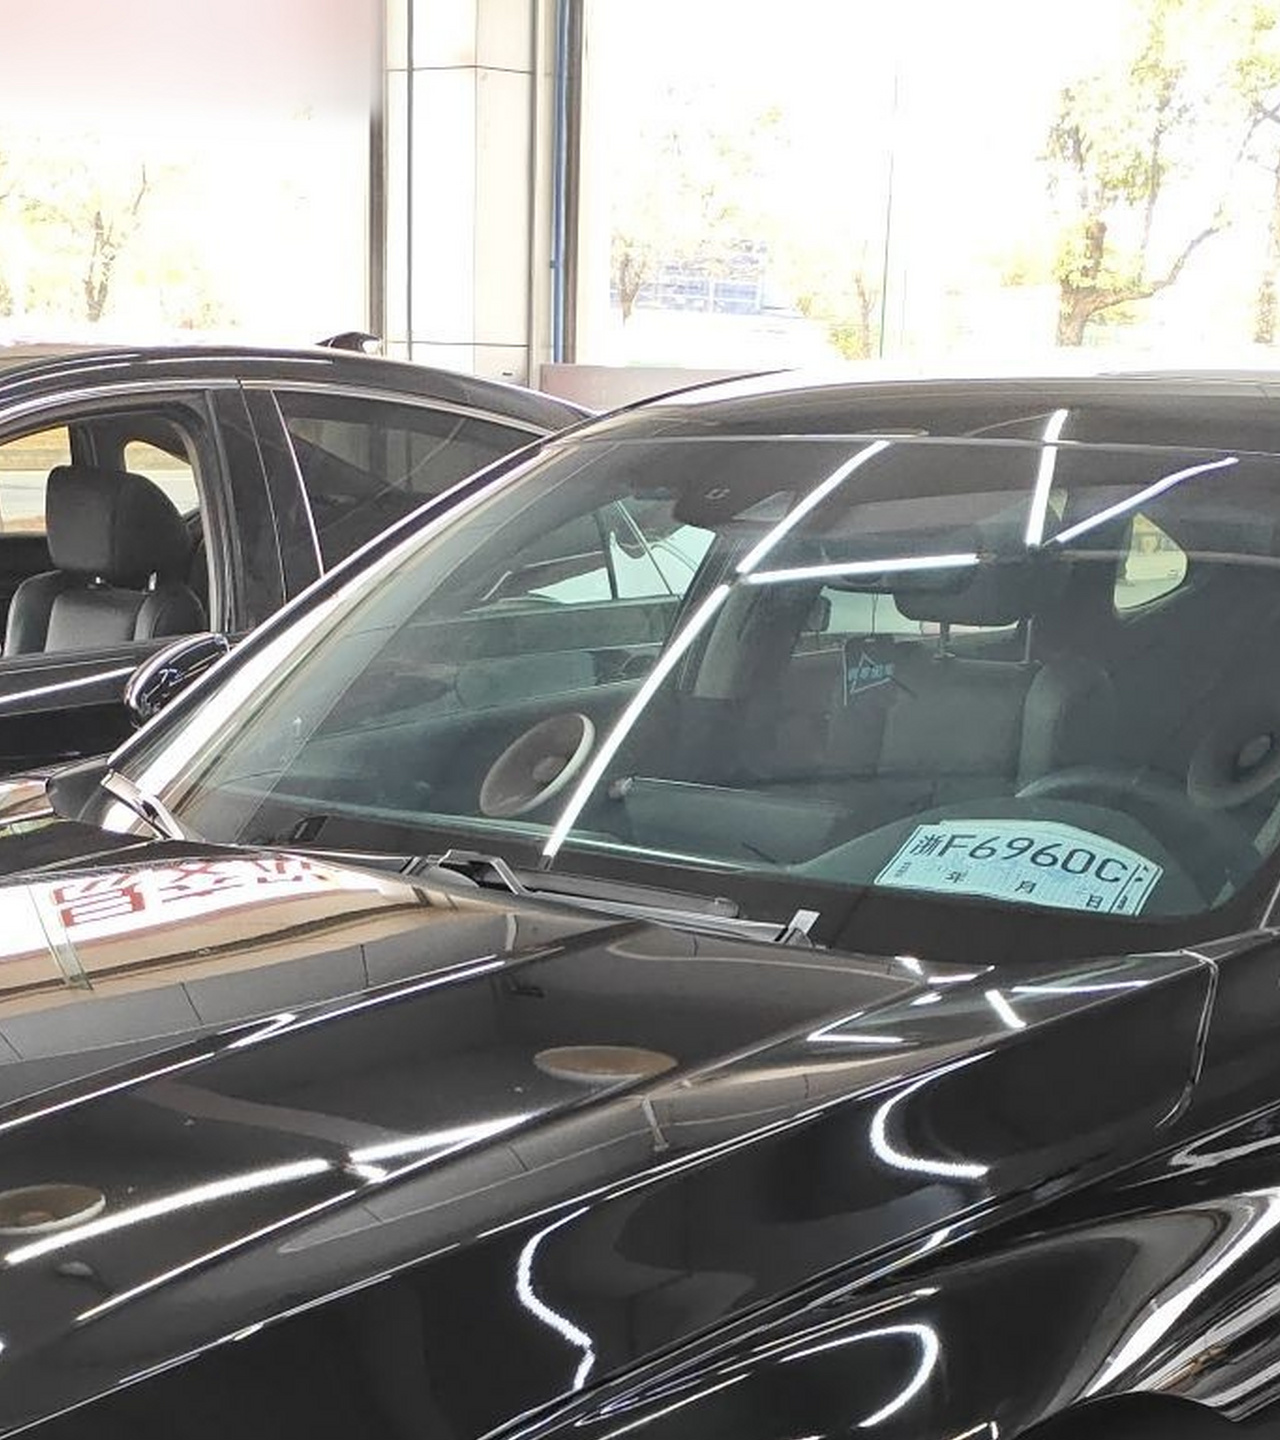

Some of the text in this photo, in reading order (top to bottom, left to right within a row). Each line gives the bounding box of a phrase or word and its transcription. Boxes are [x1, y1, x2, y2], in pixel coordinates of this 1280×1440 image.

[910, 833, 1128, 883] 浙F6960C
[945, 869, 967, 884] 年
[1014, 880, 1037, 894] 月
[1085, 894, 1104, 910] 日
